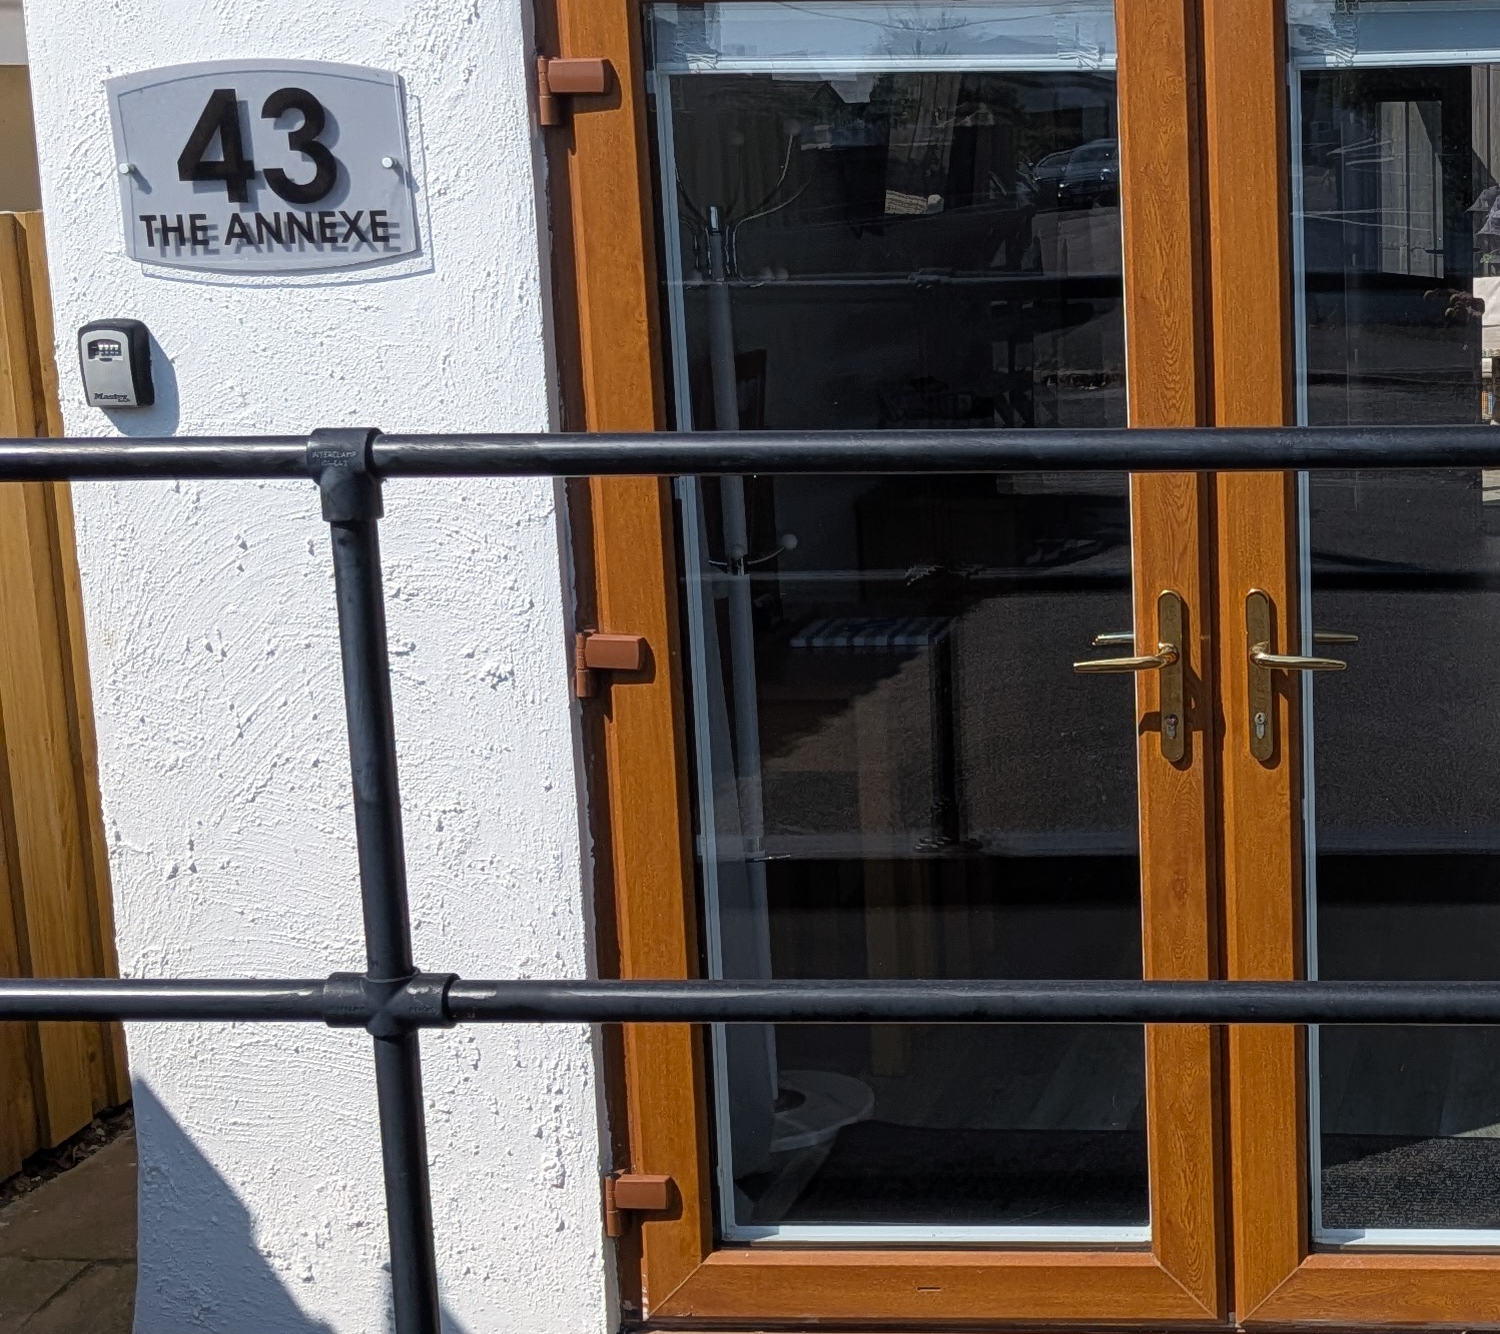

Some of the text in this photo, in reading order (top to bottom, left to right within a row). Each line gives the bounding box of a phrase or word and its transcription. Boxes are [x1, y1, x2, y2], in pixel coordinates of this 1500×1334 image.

[177, 87, 338, 204] 43
[139, 209, 390, 247] THE ANNEXE
